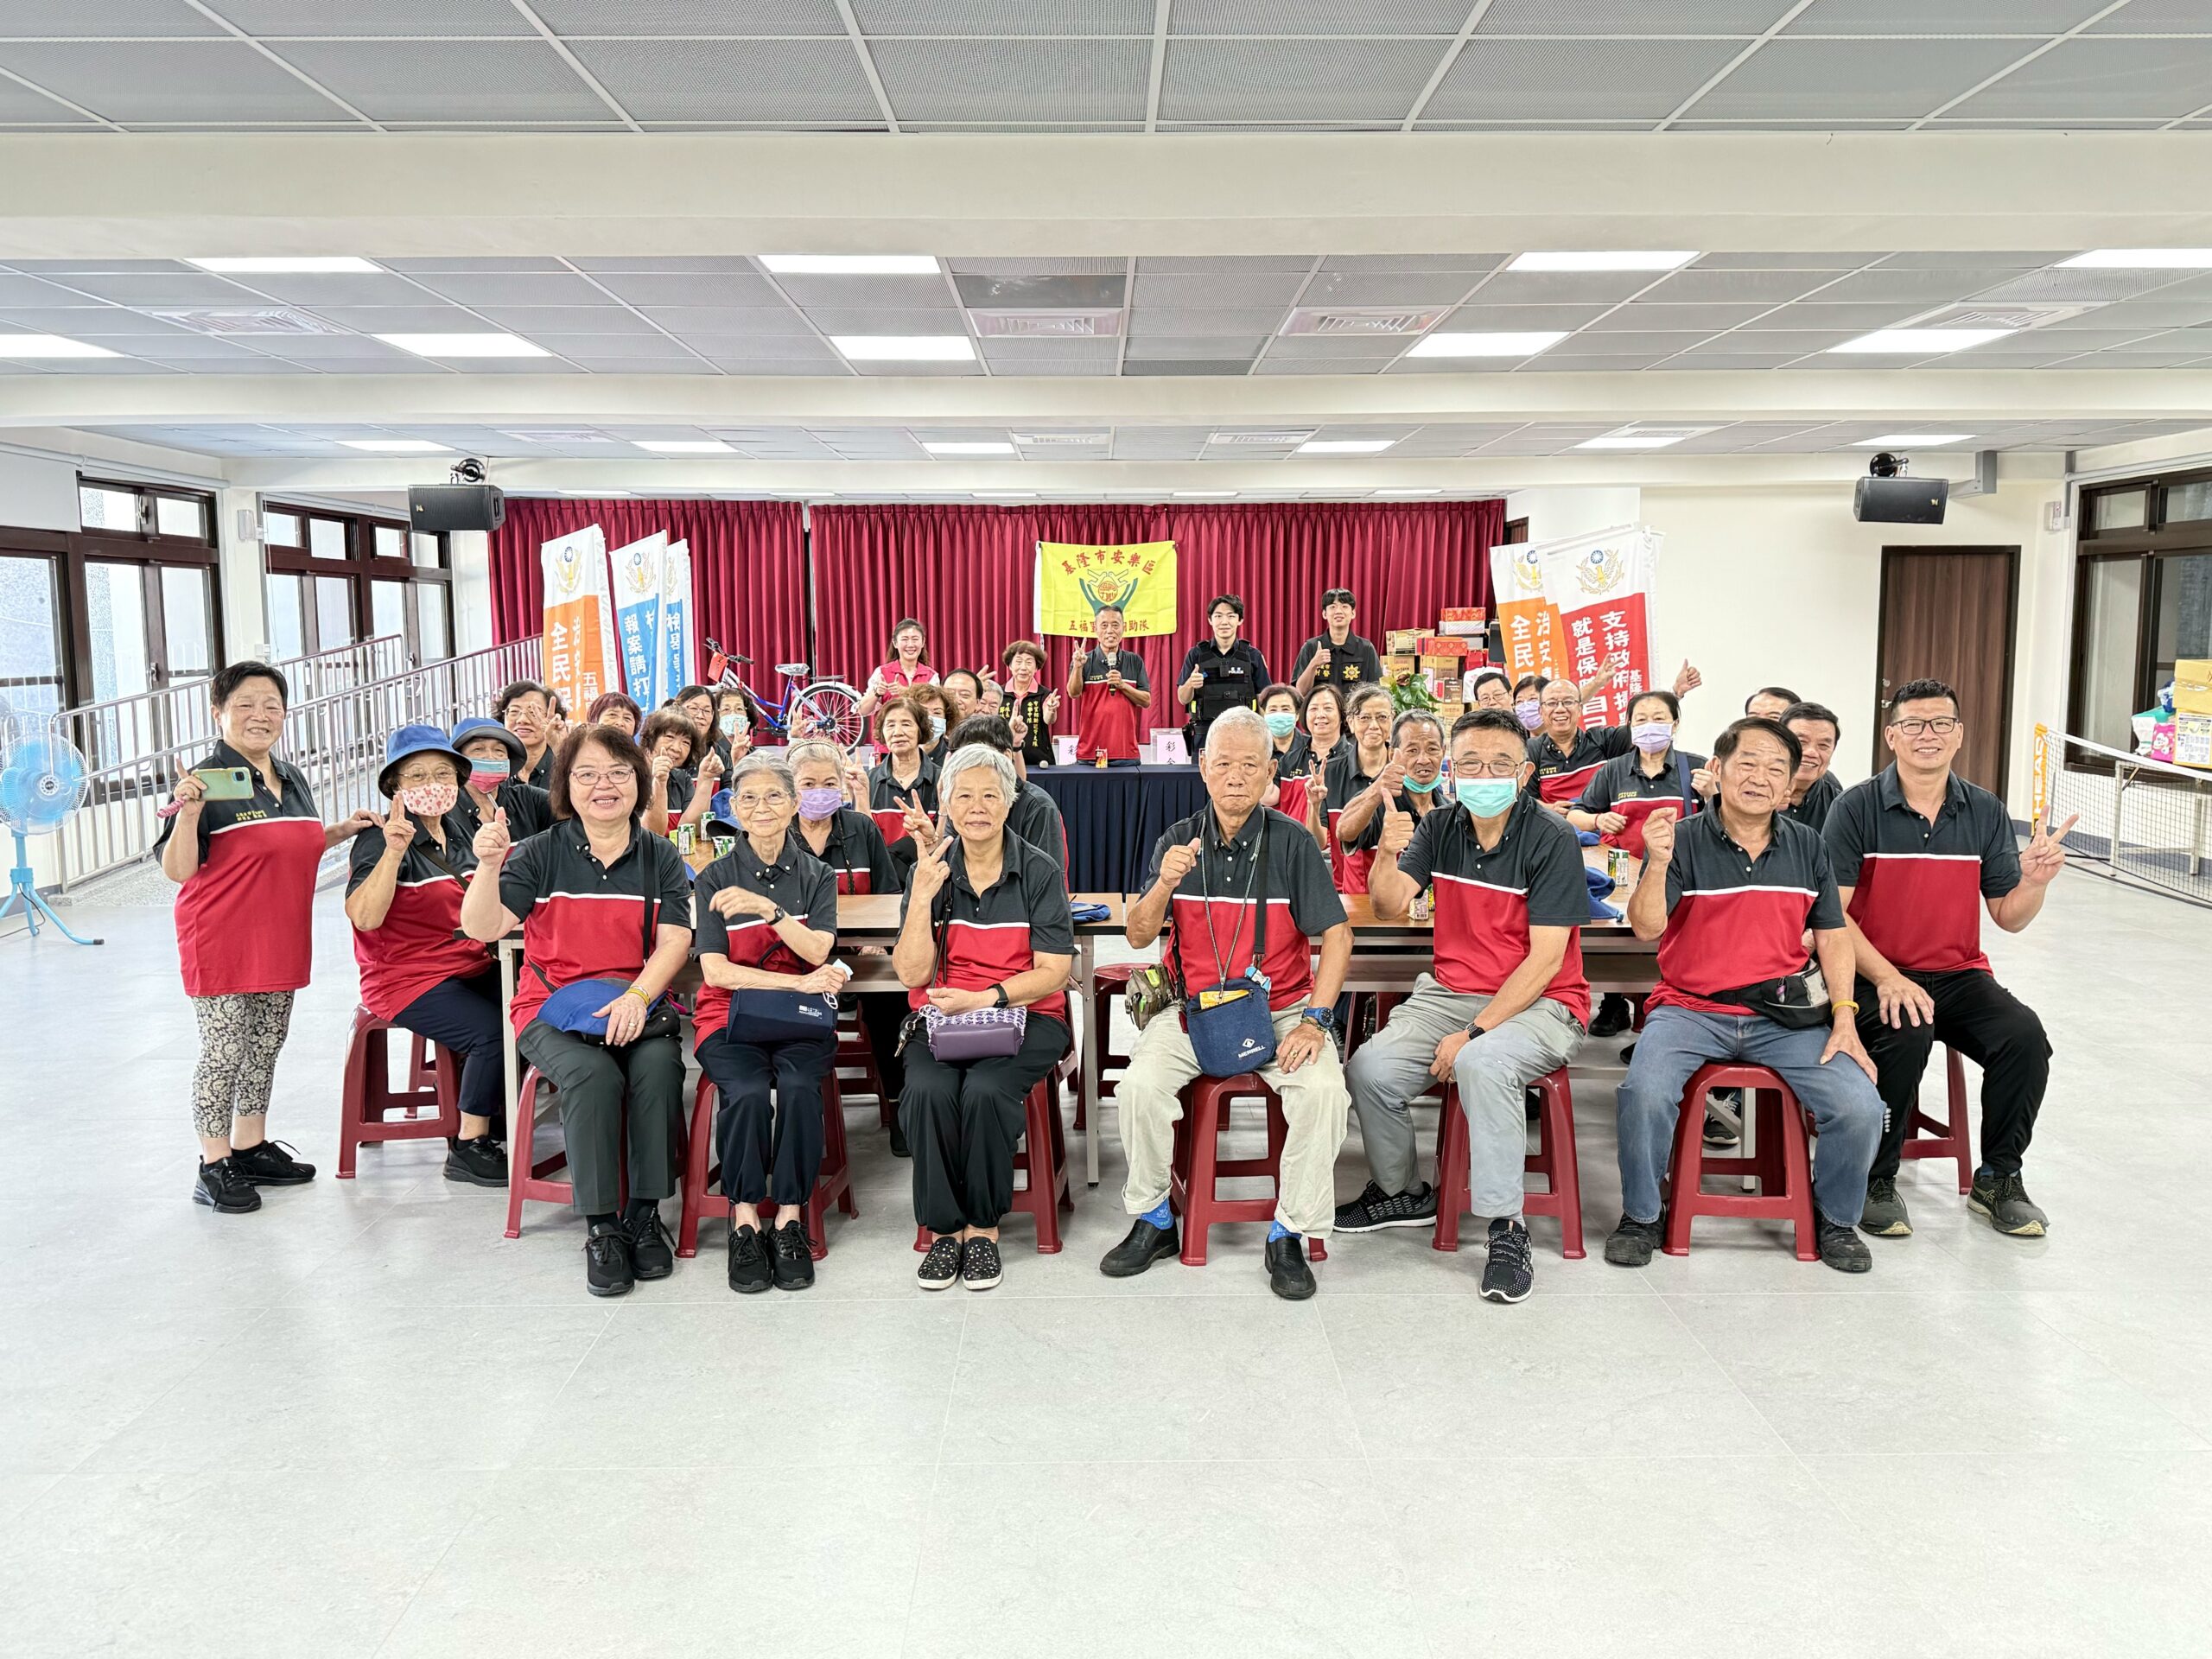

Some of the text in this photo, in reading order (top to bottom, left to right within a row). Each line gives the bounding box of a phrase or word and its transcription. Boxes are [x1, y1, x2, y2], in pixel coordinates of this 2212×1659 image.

[1062, 550, 1155, 575] 基隆市安樂區
[582, 671, 600, 710] 五福
[2034, 735, 2045, 814] HEAD
[1237, 1045, 1267, 1058] MERRELL
